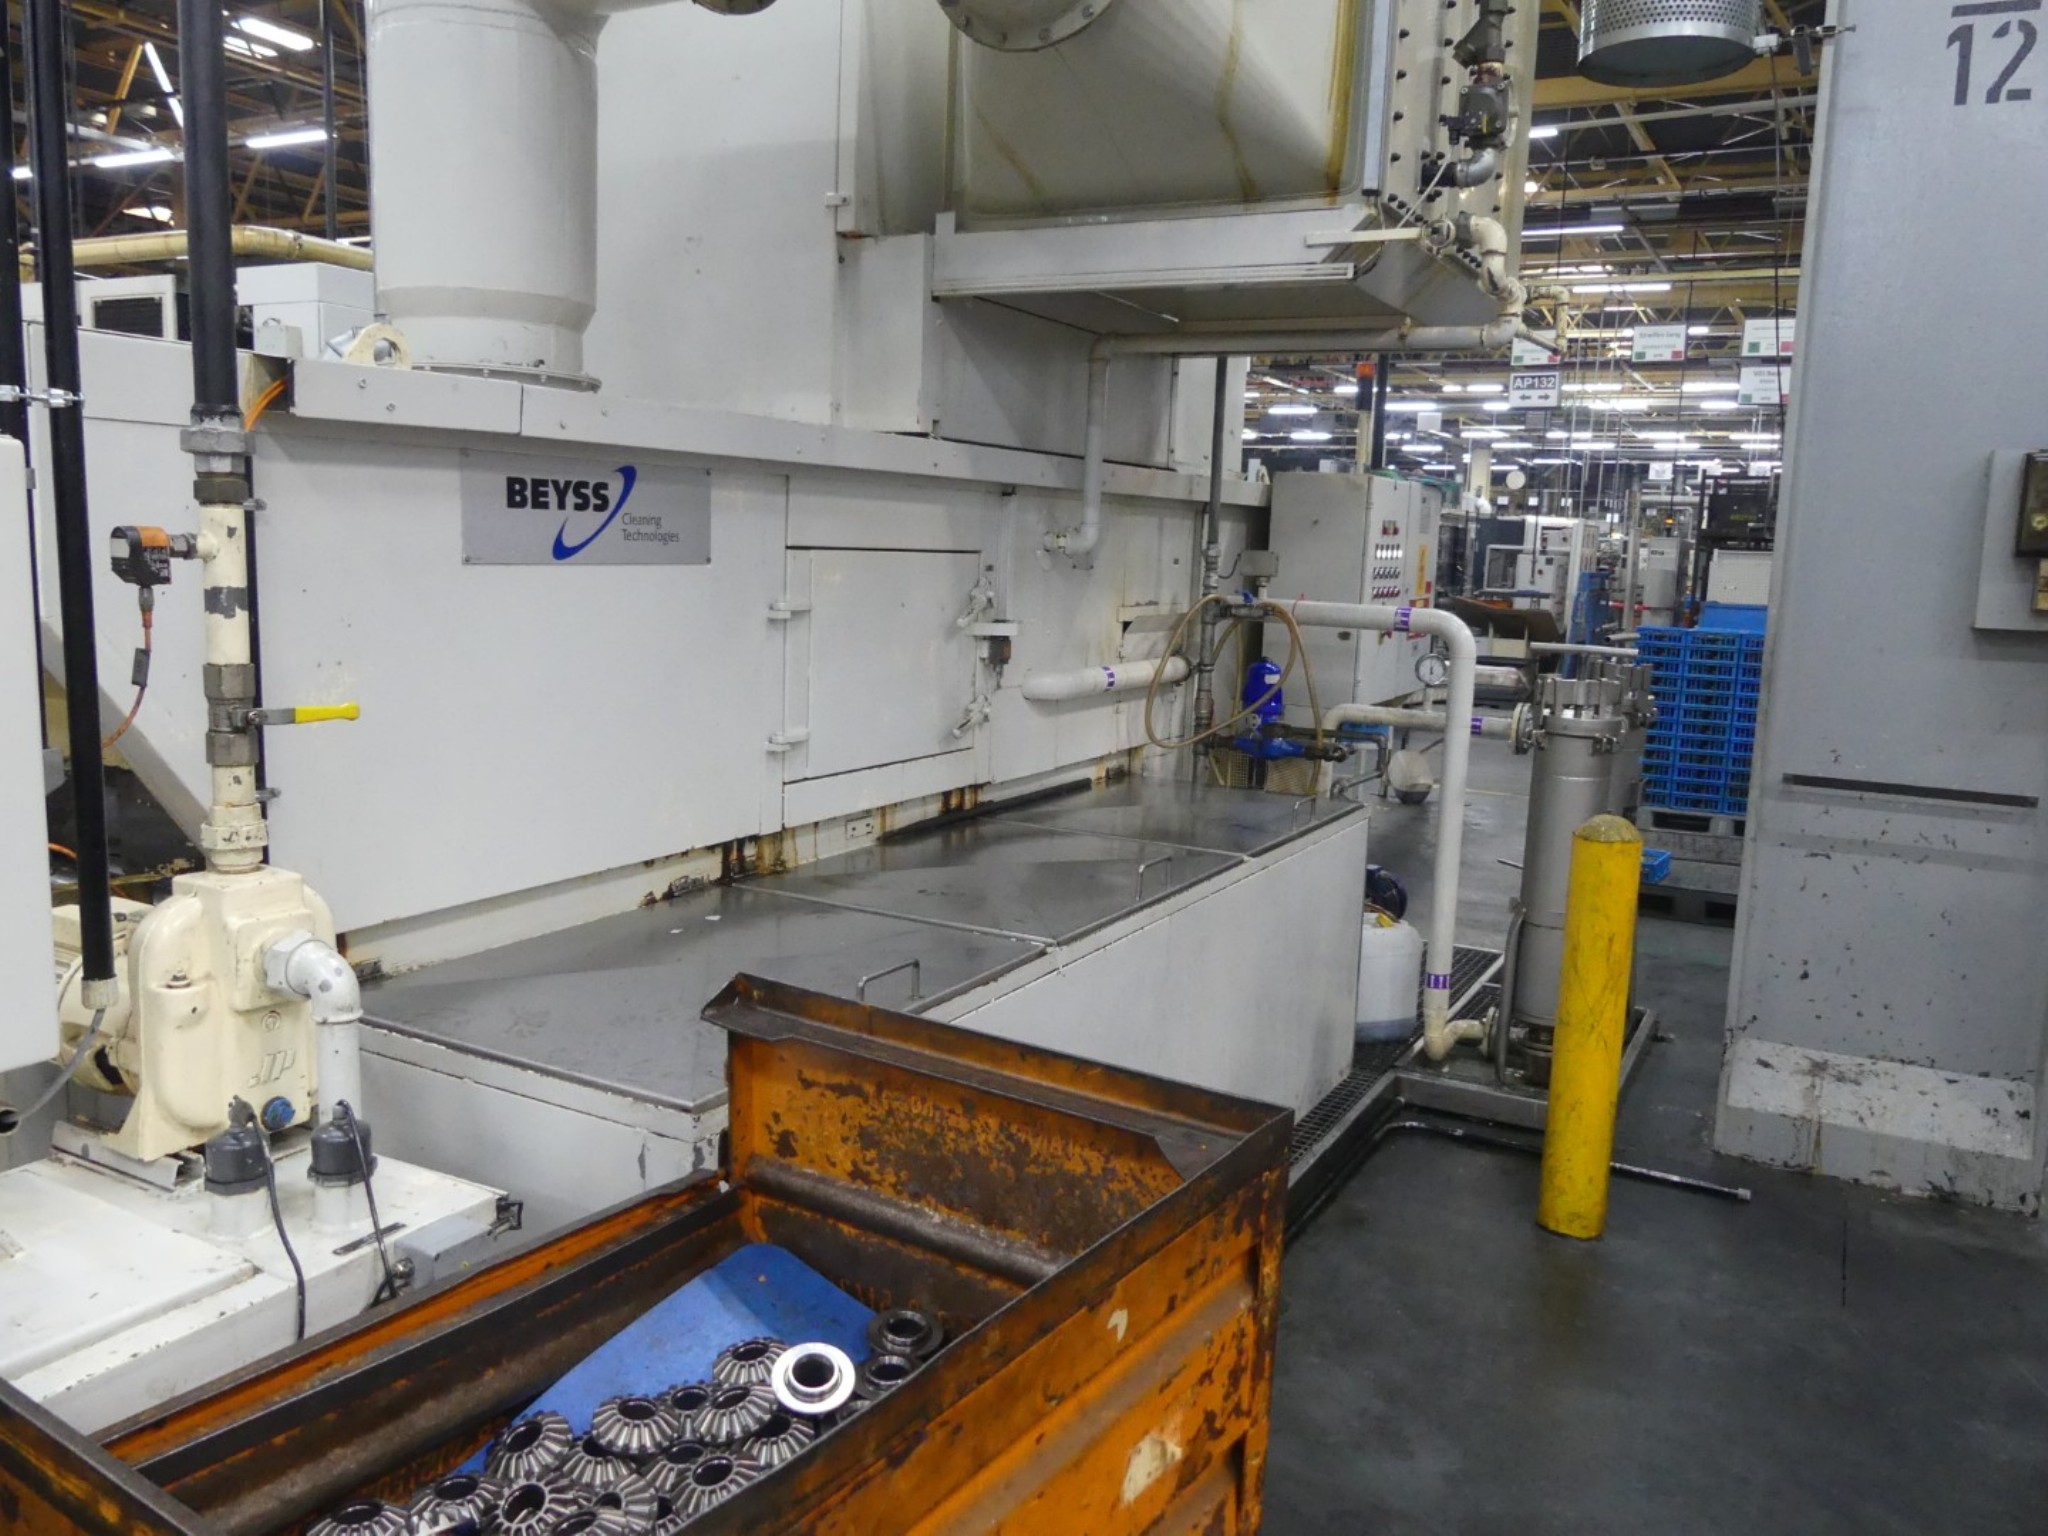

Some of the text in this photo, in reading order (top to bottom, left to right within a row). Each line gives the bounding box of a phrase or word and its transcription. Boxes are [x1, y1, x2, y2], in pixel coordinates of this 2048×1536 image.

[1946, 18, 2038, 106] 12
[1513, 376, 1555, 389] AP132
[506, 475, 610, 513] BEYSS
[621, 512, 662, 529] Cleaning
[621, 529, 680, 546] Technologies
